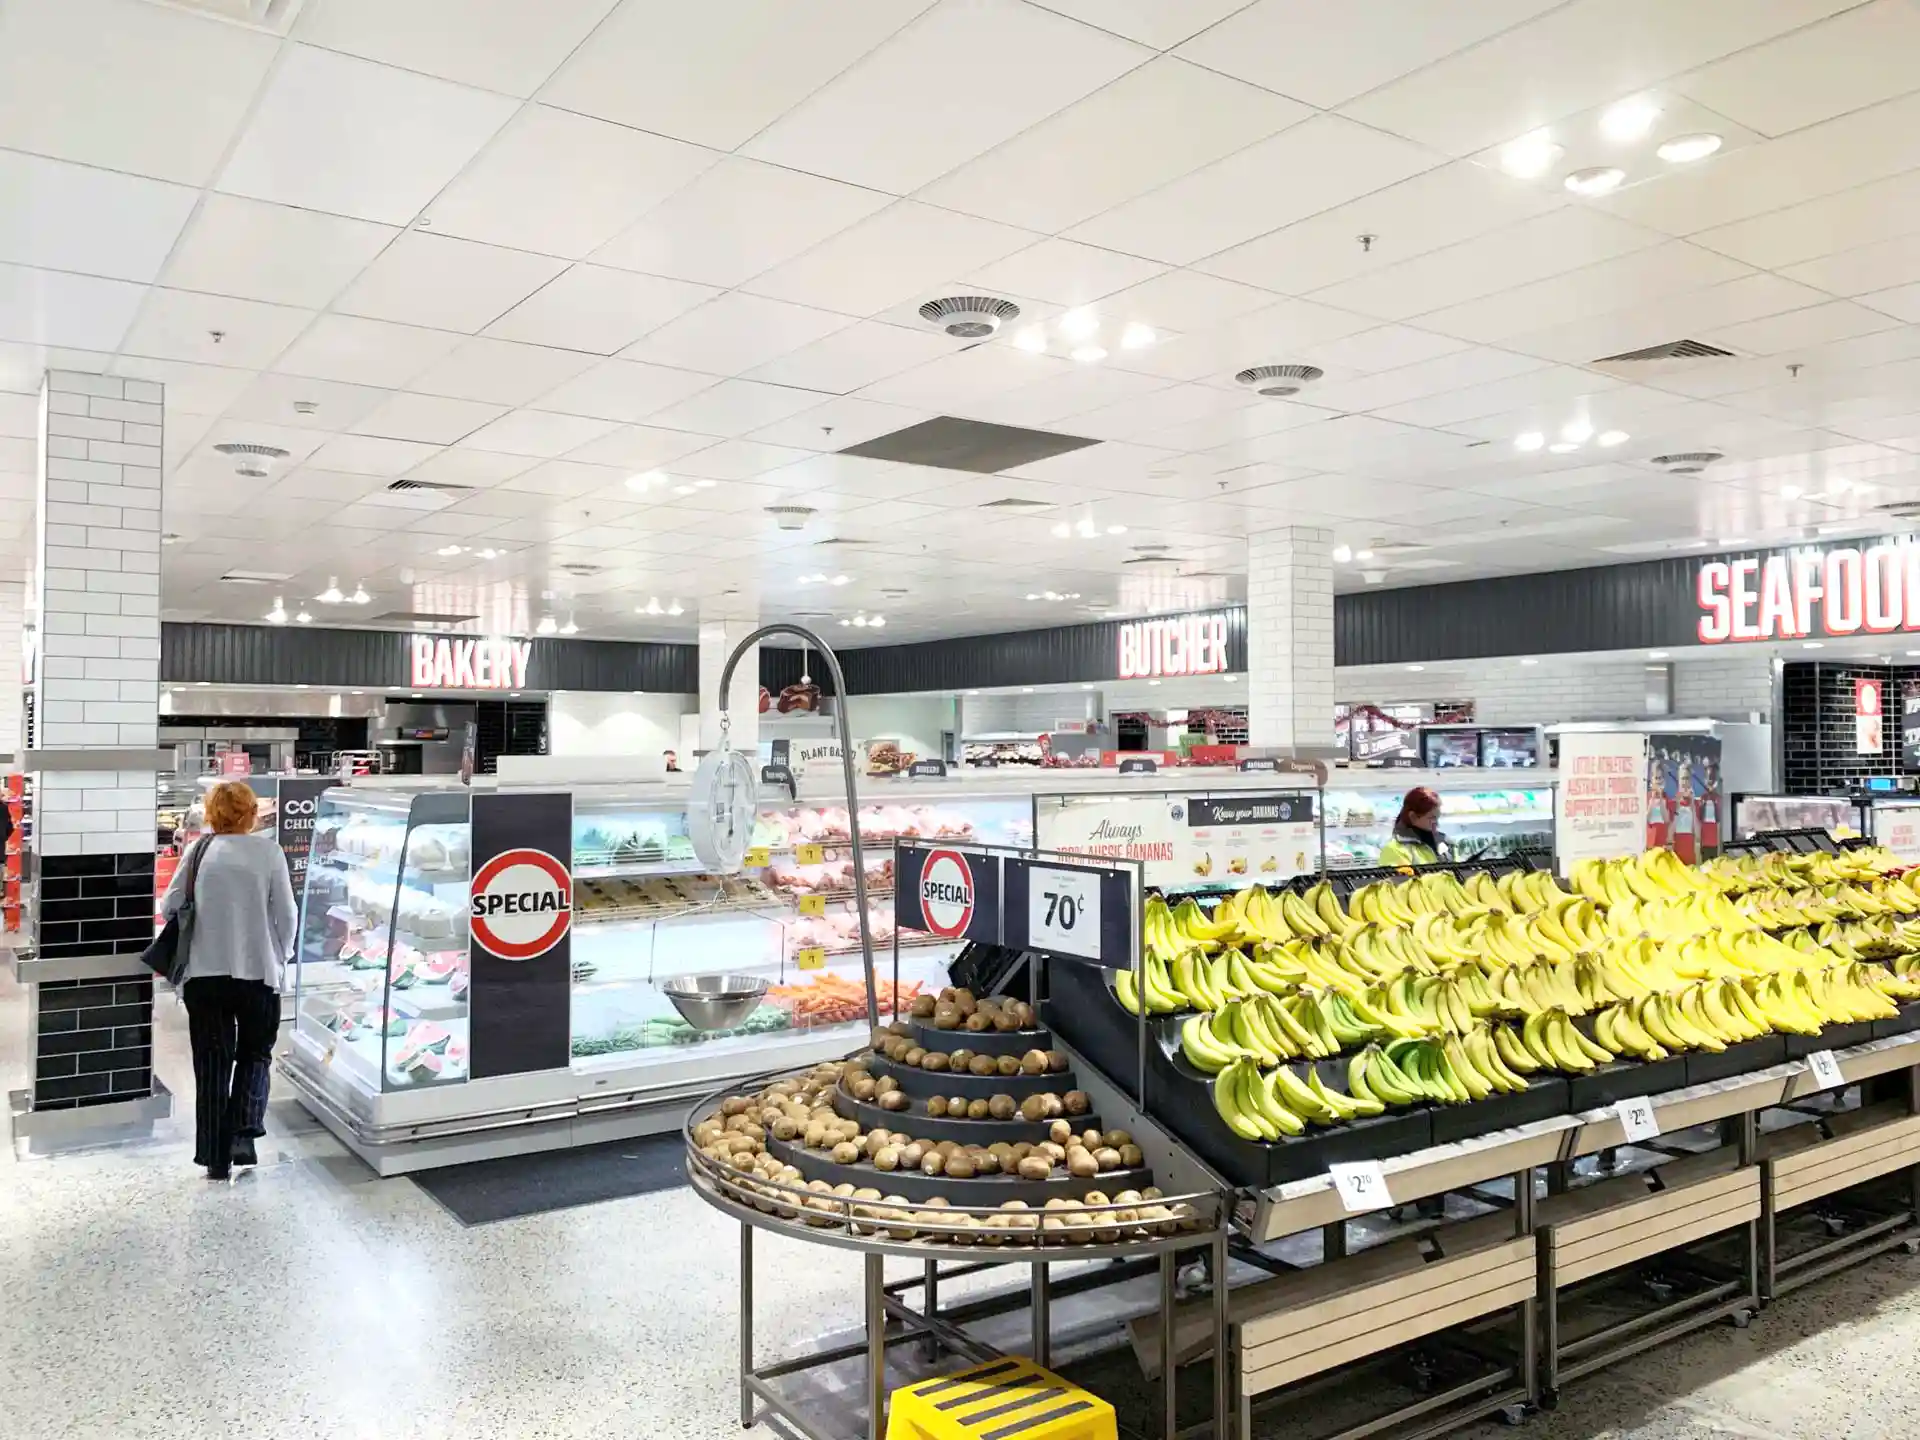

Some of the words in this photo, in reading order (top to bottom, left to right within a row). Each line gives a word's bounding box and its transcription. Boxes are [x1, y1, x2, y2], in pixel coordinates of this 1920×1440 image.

[1118, 614, 1228, 680] BUTCHER
[411, 633, 532, 688] BAKERY
[801, 746, 827, 761] PLANT
[829, 743, 857, 760] BASD
[1252, 805, 1279, 818] BANANAS
[1088, 819, 1144, 842] Always
[1126, 842, 1173, 862] BANANAS
[472, 889, 570, 915] SPECIAL
[923, 880, 969, 905] SPECIAL
